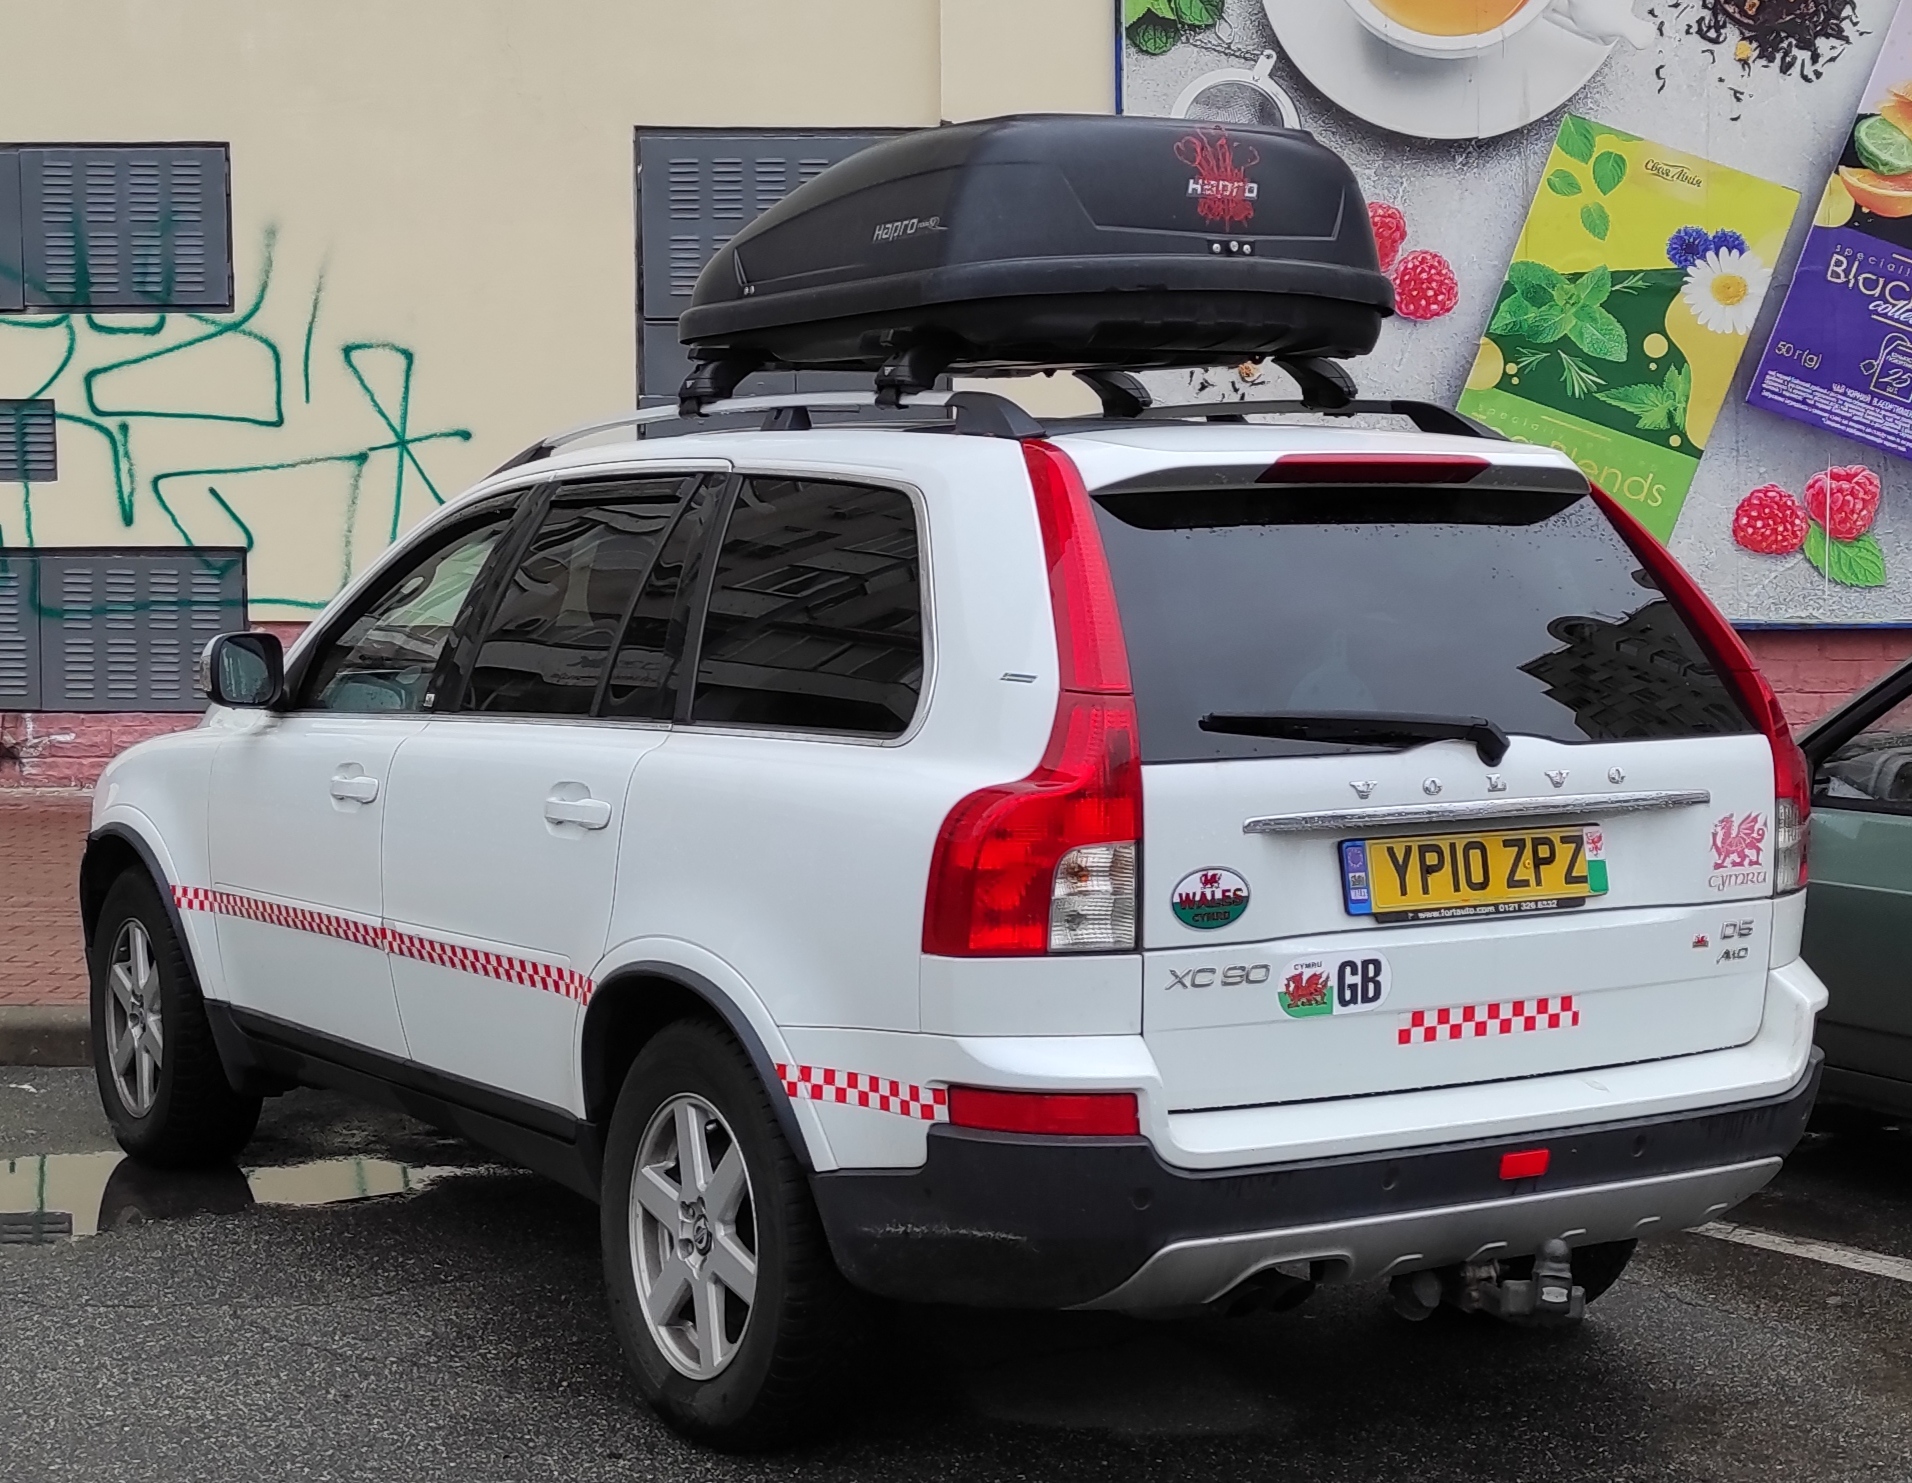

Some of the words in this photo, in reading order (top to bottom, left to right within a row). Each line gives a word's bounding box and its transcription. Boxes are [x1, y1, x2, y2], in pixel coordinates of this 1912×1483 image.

[873, 217, 918, 242] Hapro
[1826, 253, 1912, 309] Blac
[1868, 300, 1912, 325] colle
[1775, 341, 1794, 357] 50
[1878, 367, 1912, 388] 25
[1350, 766, 1626, 799] VOLVO
[1387, 840, 1490, 897] YP10
[1503, 834, 1588, 889] ZPZ
[1178, 887, 1244, 911] WALES
[1499, 902, 1518, 912] 0121
[1720, 919, 1755, 941] D5
[1293, 961, 1322, 970] CYMRU
[1337, 958, 1382, 1007] GB
